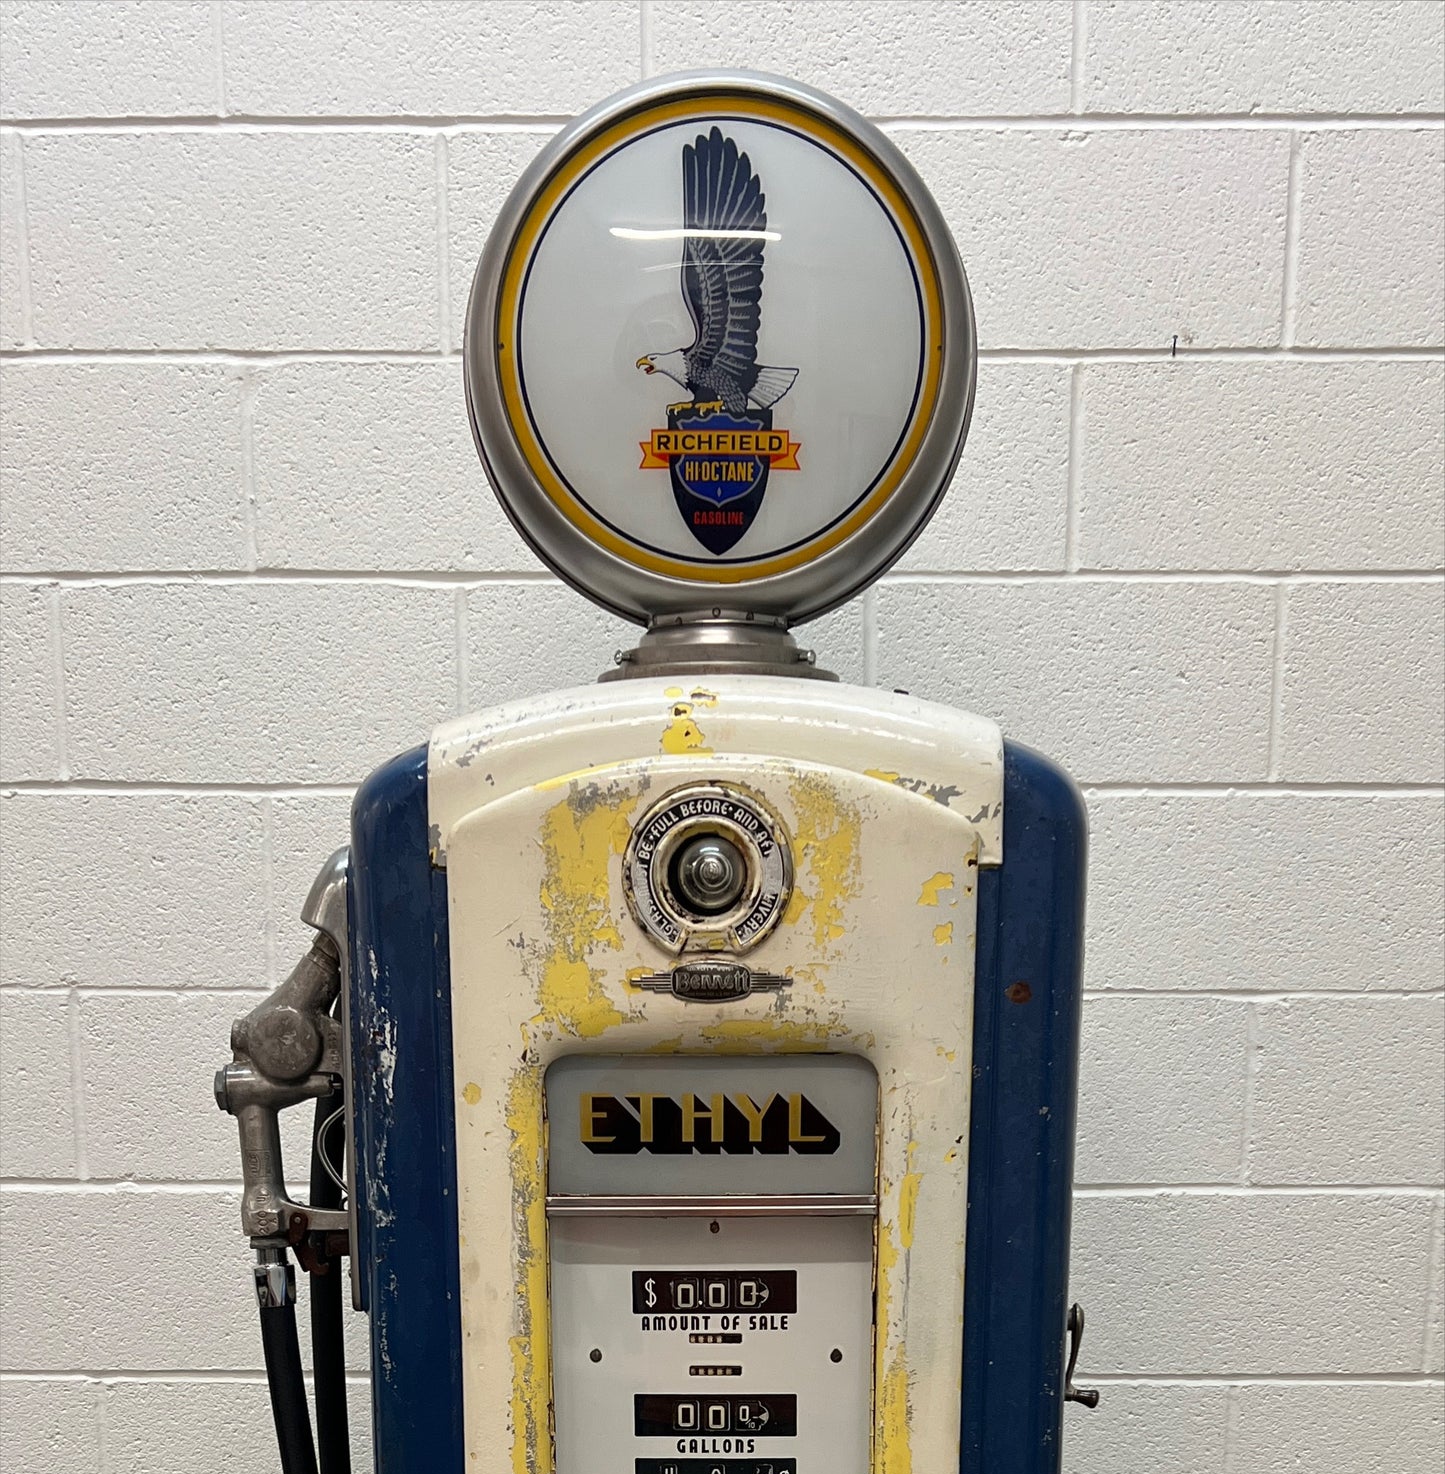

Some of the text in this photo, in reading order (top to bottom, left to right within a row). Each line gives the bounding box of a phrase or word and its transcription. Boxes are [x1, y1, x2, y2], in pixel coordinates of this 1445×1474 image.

[657, 434, 783, 451] RICHFIELD
[693, 511, 744, 525] GASOLINE
[638, 840, 653, 860] BE
[734, 807, 758, 834] AND
[675, 970, 749, 992] Bennett
[580, 1092, 840, 1155] ETHYL
[641, 1315, 788, 1331] AMOUNT OF SALE
[677, 1438, 756, 1454] GALLONS
